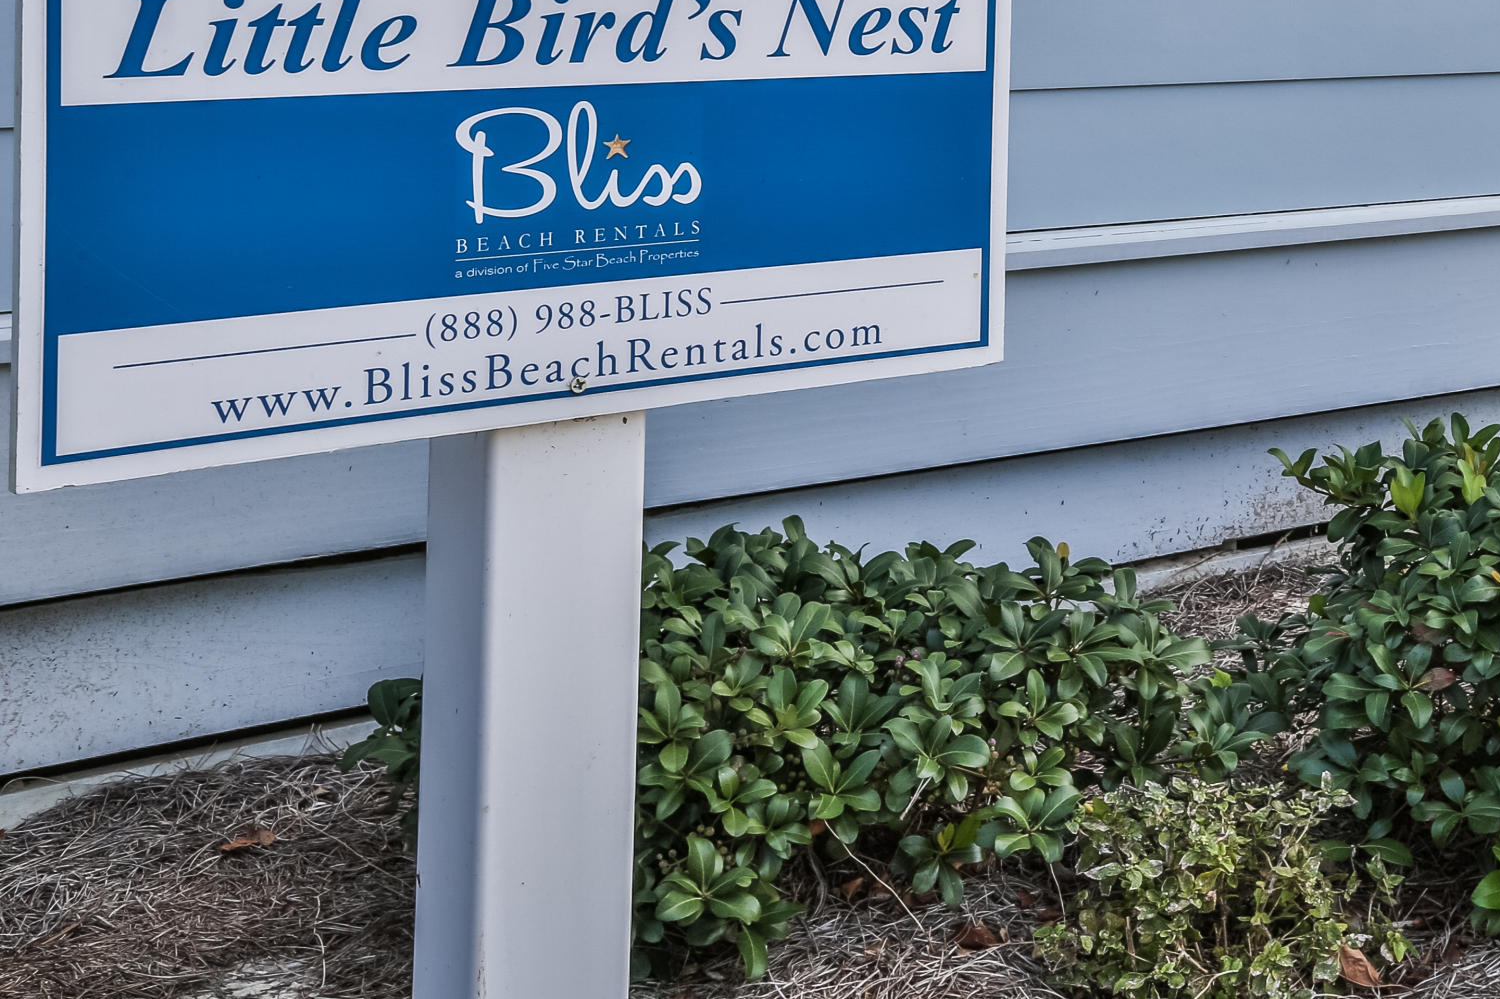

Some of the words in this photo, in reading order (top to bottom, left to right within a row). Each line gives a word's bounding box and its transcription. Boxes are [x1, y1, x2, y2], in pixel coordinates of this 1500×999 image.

[455, 100, 702, 225] Bliss
[454, 270, 463, 279] a
[465, 264, 513, 278] division
[516, 262, 529, 273] of
[533, 258, 560, 273] Five
[562, 255, 594, 271] Star
[596, 250, 637, 268] Beach
[640, 249, 700, 265] Properties
[456, 231, 553, 254] BEACH
[575, 220, 701, 244] RENTALS
[425, 305, 518, 349] (888)
[535, 287, 712, 335] 988-BLISS
[211, 323, 883, 424] www.BlissBeachRentals.com
